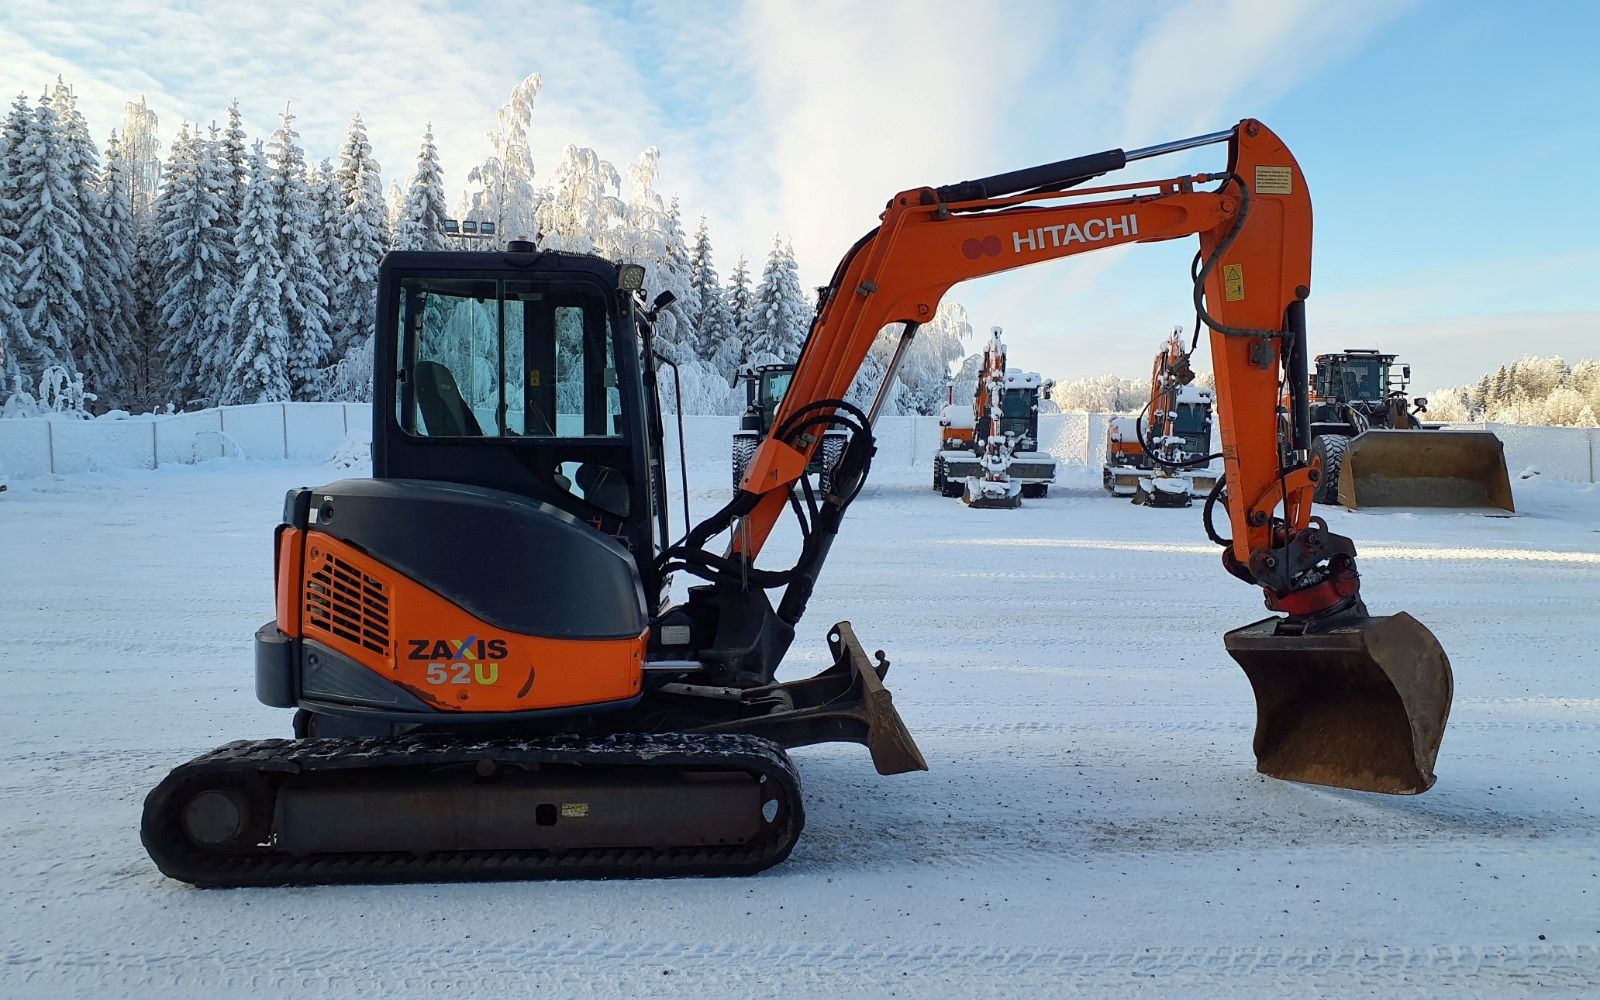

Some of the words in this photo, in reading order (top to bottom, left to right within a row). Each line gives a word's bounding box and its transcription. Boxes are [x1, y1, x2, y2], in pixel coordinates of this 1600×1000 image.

[1013, 214, 1138, 252] HITACHI
[408, 635, 508, 660] ZAXIS
[427, 662, 499, 685] 52U
